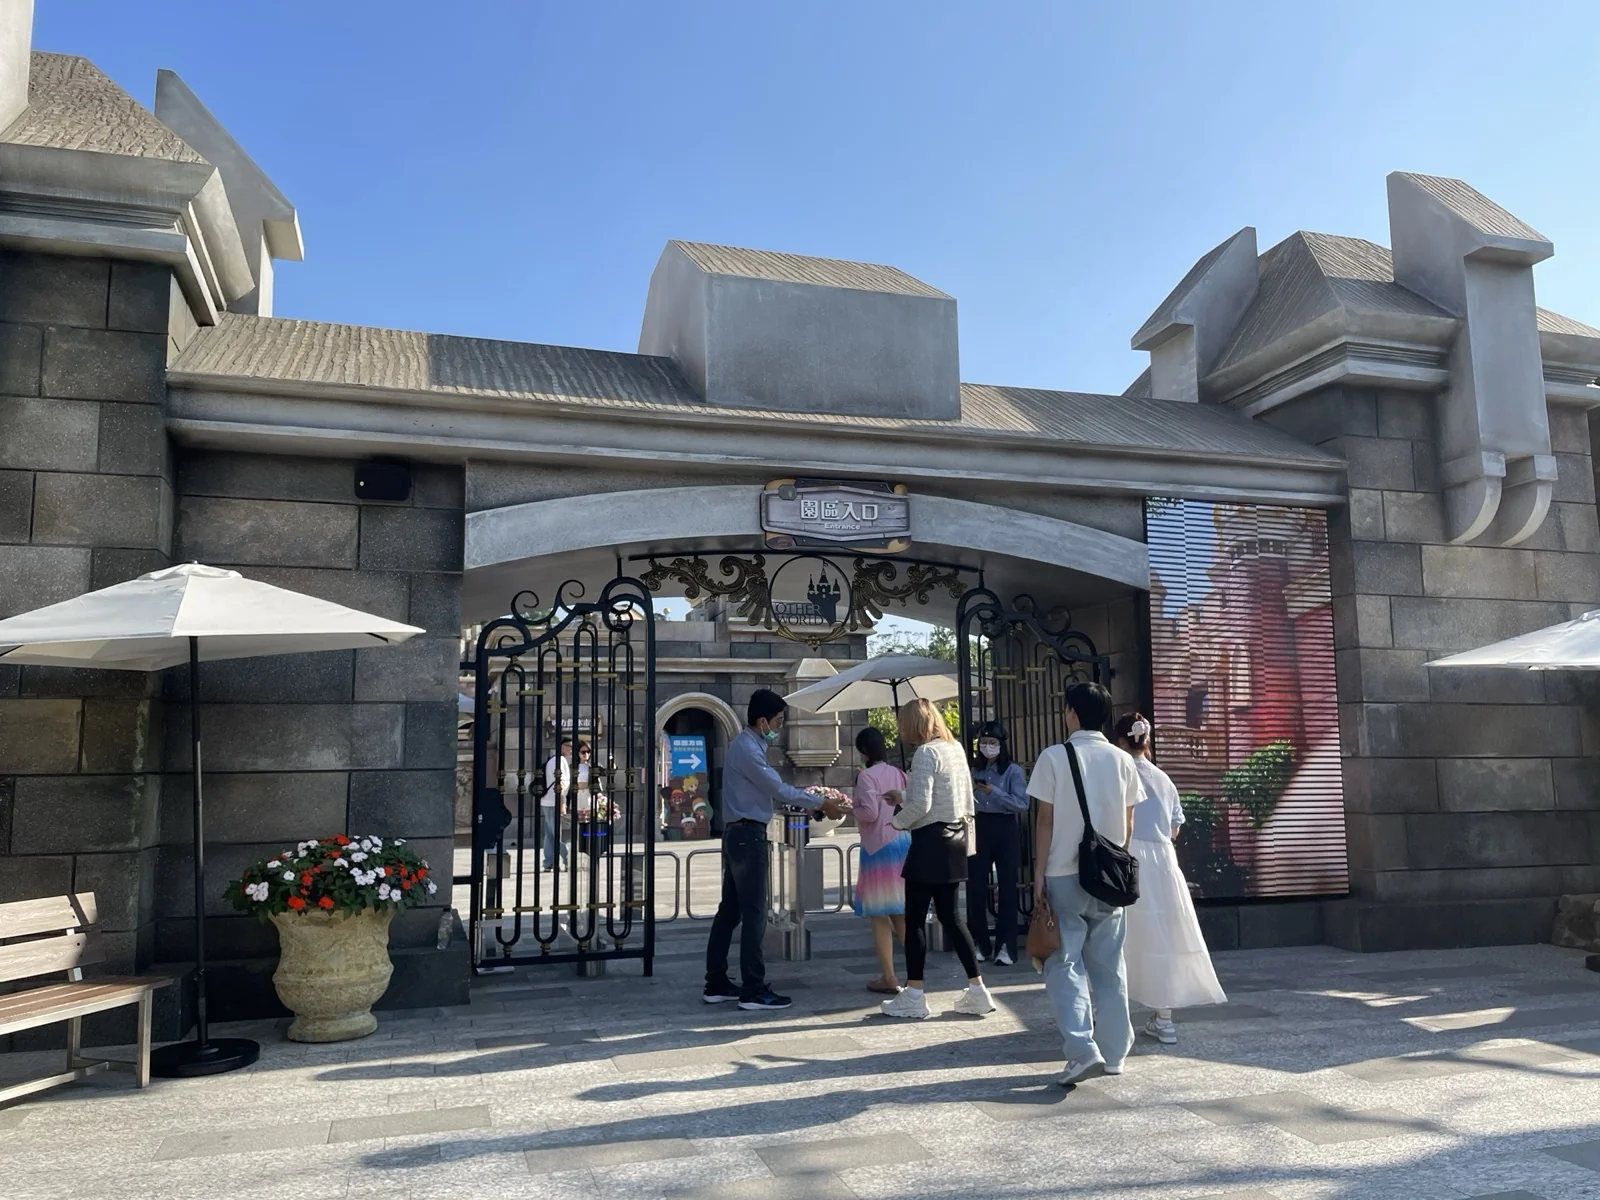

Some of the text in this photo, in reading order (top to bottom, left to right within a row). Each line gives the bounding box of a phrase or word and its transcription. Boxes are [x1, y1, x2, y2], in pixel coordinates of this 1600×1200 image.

[800, 499, 879, 521] 園區入口
[776, 602, 822, 615] OTHER
[776, 615, 824, 625] WORLD
